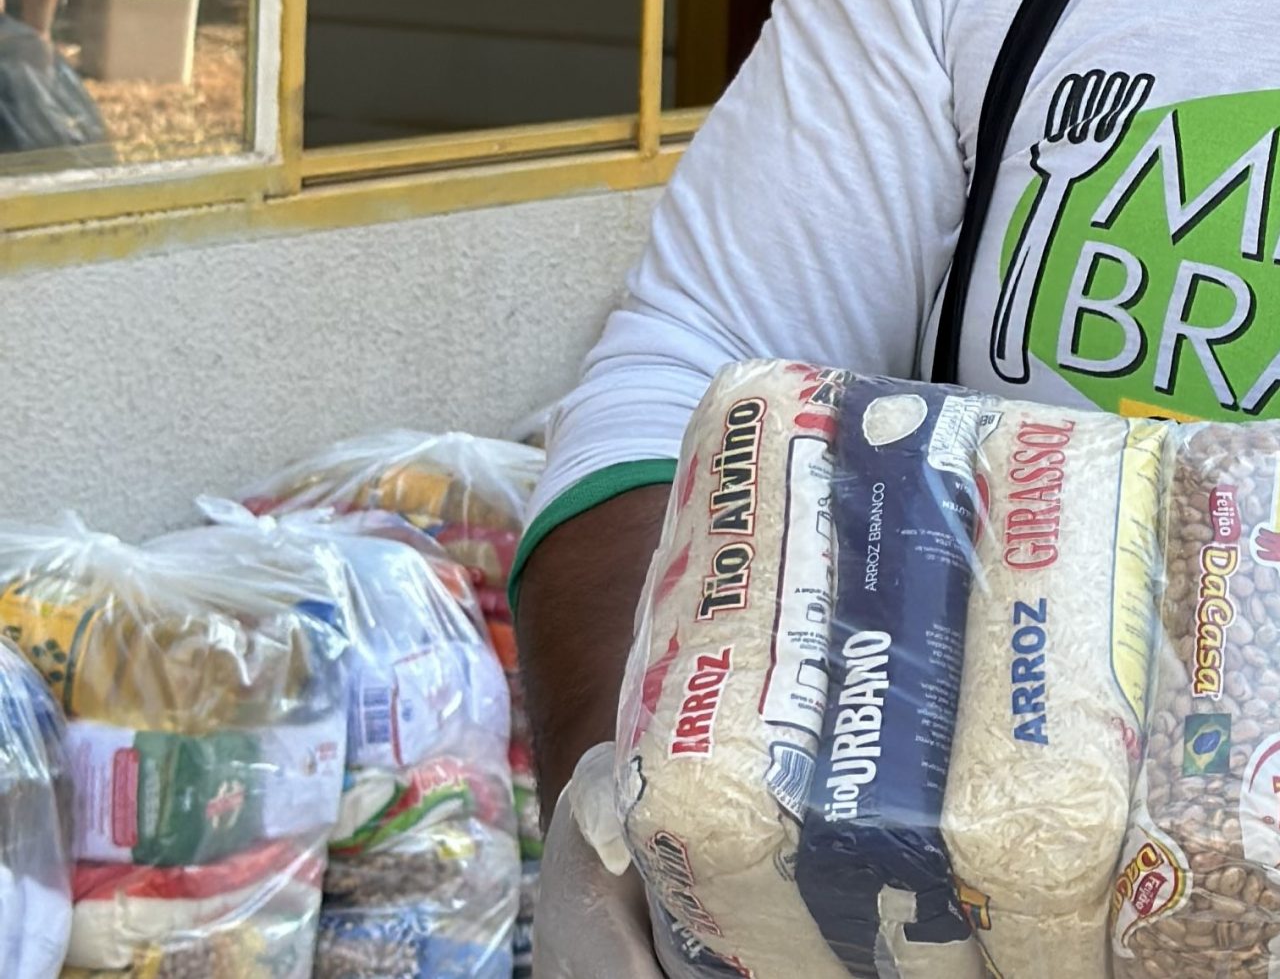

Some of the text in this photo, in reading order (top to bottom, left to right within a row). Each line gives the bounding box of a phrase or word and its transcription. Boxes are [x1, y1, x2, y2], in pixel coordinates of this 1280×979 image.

[697, 397, 767, 621] Tio Alvino
[864, 482, 885, 591] ARROZ BRANCO
[1003, 420, 1076, 570] GIRASSOL
[1215, 491, 1234, 537] Feijão
[1012, 597, 1049, 746] ARROZ
[1192, 543, 1240, 700] DaCasa
[668, 644, 734, 760] ARROZ
